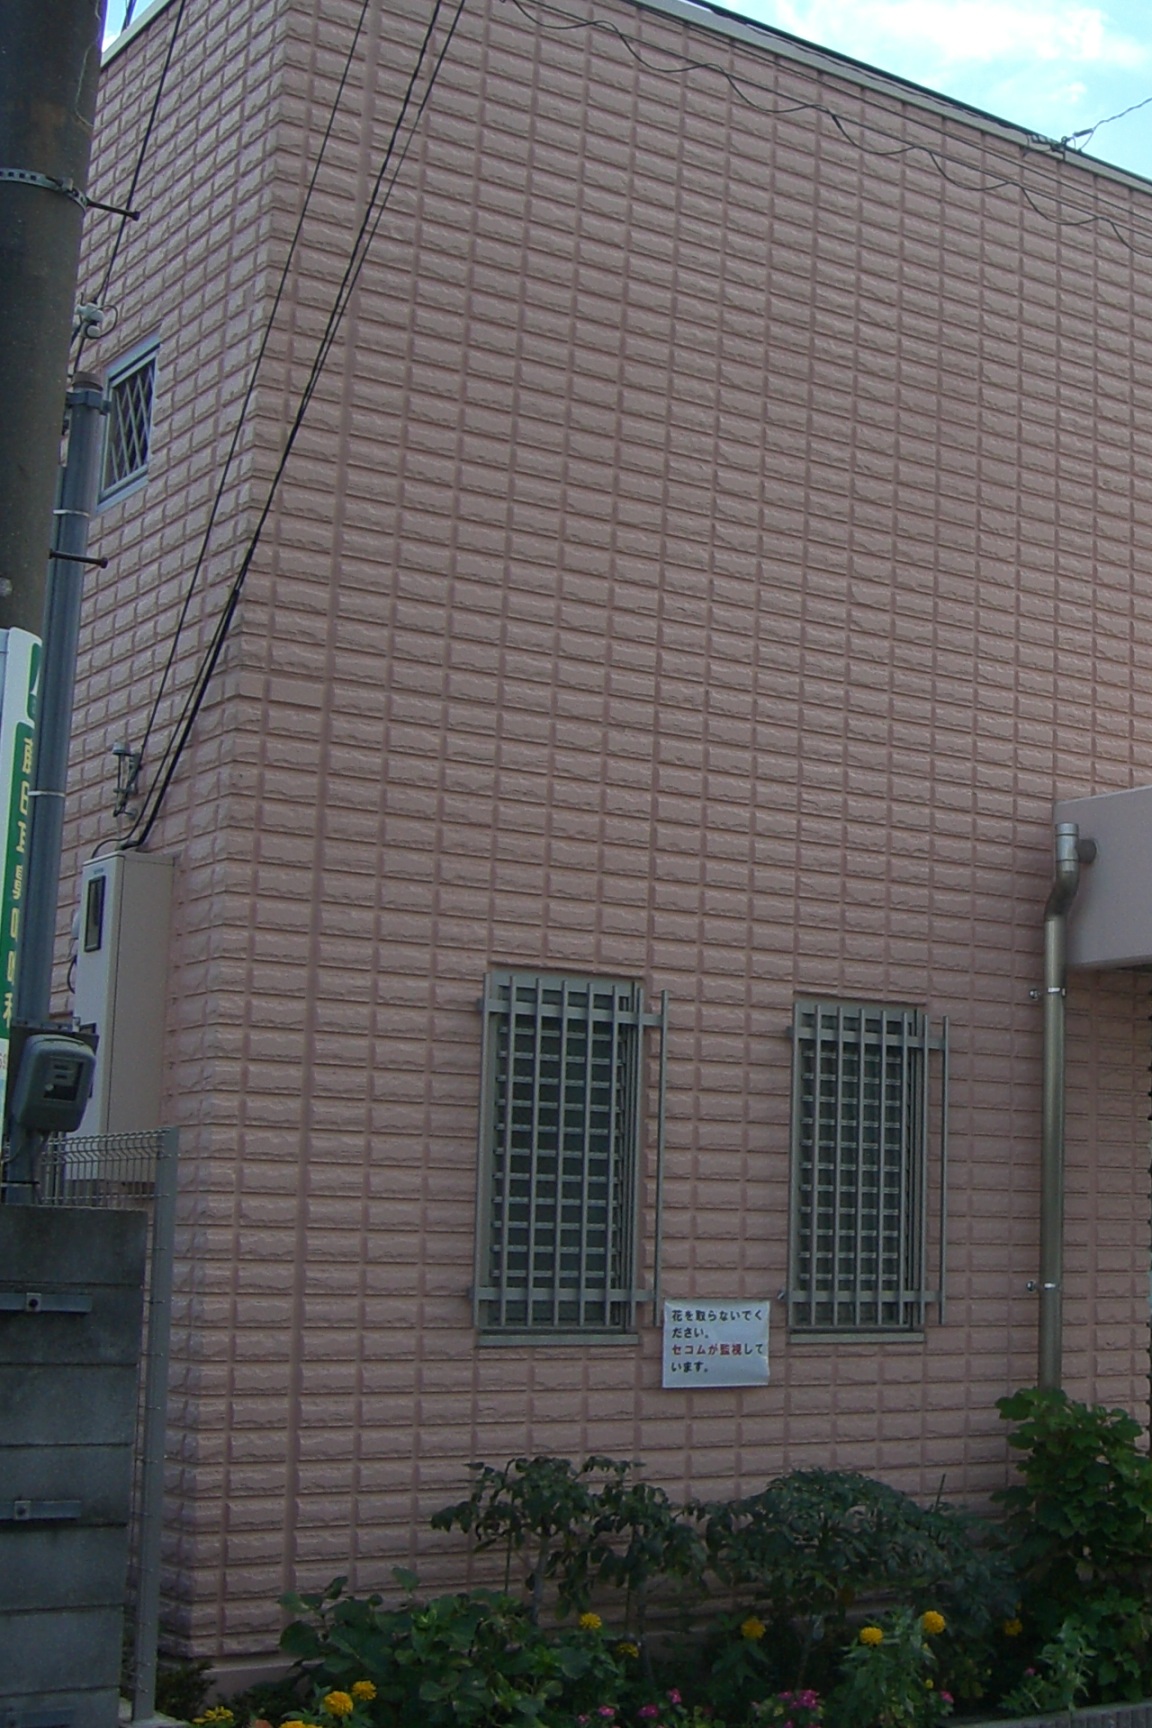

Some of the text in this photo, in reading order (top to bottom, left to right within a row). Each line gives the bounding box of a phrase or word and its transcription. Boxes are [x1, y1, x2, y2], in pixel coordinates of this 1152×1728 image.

[671, 1309, 763, 1322] 花を取らないでく
[671, 1327, 709, 1339] ださい。
[671, 1343, 764, 1356] セコムが監視して
[671, 1361, 708, 1373] います。
